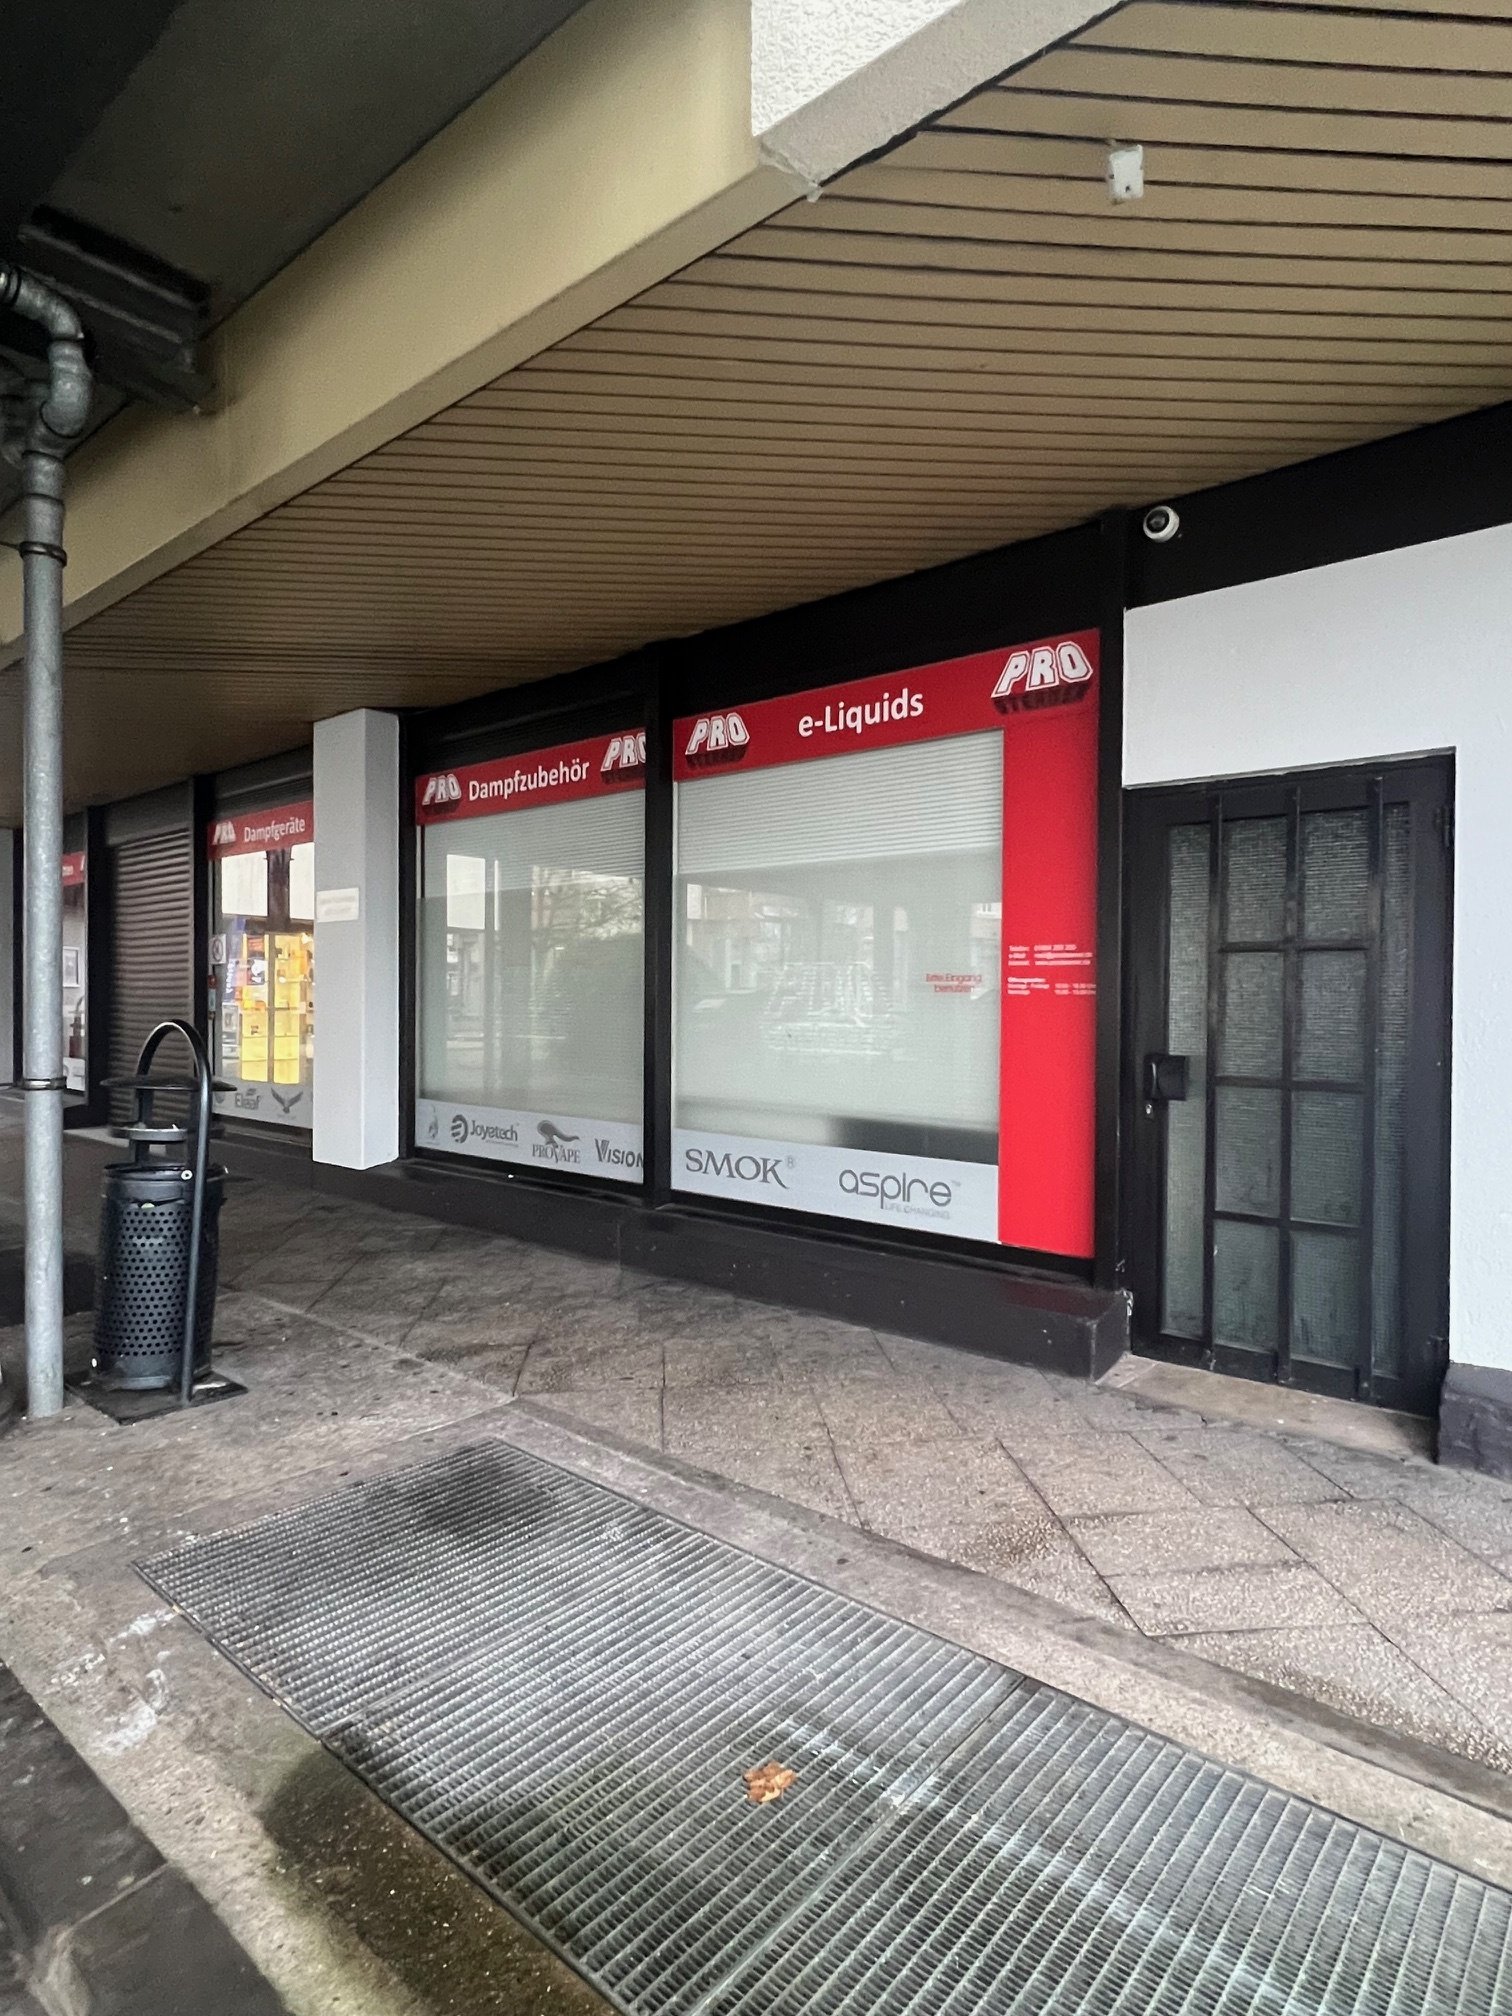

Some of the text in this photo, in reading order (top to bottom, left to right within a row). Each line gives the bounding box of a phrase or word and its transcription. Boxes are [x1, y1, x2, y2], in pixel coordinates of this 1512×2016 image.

[685, 641, 1093, 755] PRO e-Liquids PRO
[421, 774, 462, 806] PRO
[468, 758, 590, 801] Dampfzubehör
[244, 816, 306, 843] Dampfgeräte
[470, 1119, 518, 1142] Joyetech
[532, 1143, 581, 1165] PROVAPE
[838, 1168, 952, 1209] aspire
